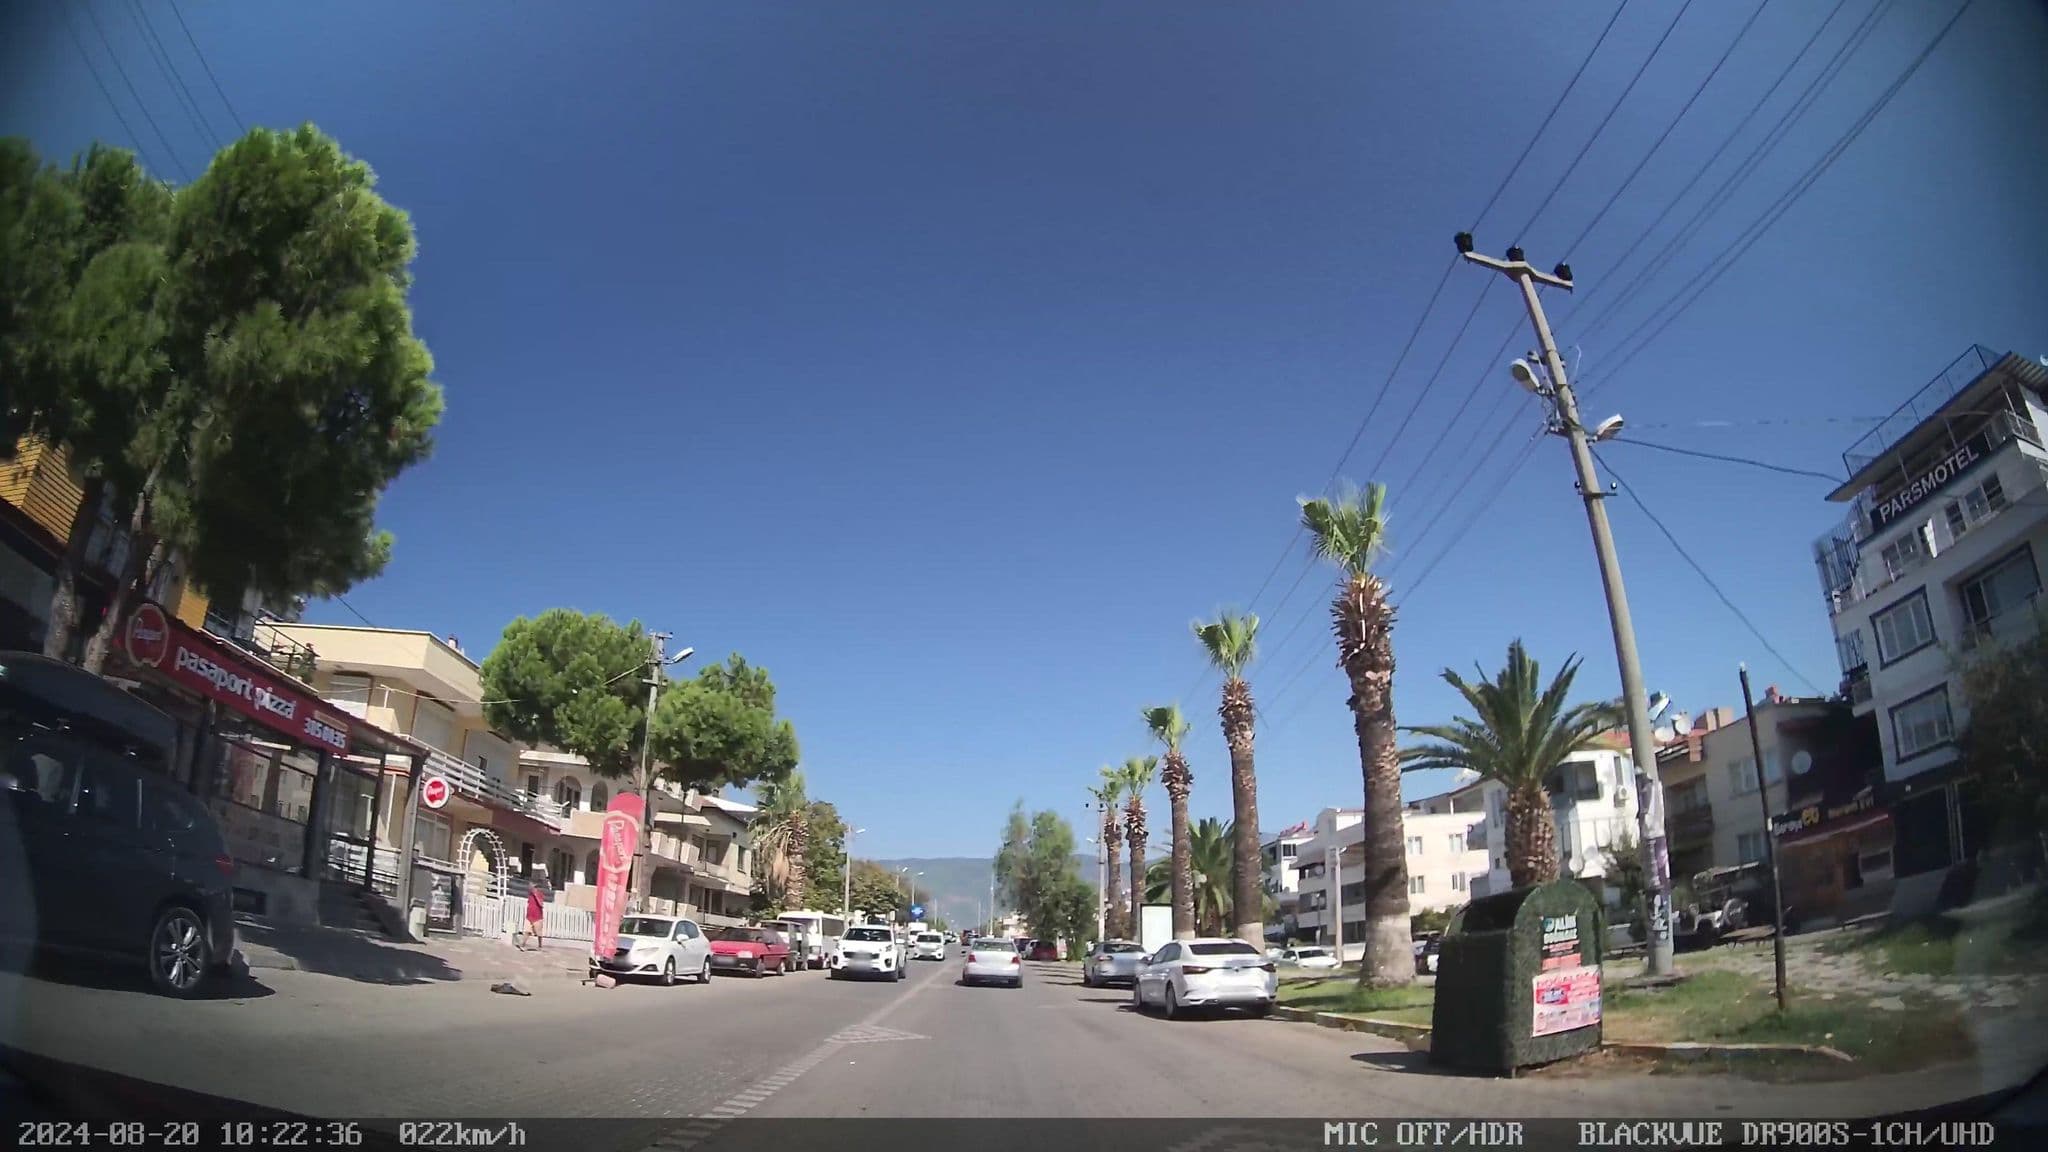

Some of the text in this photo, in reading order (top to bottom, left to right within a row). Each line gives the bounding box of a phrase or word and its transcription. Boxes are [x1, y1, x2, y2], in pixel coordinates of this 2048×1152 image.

[1878, 444, 1979, 524] PARSMOTEL
[175, 645, 297, 720] pasaport pizza
